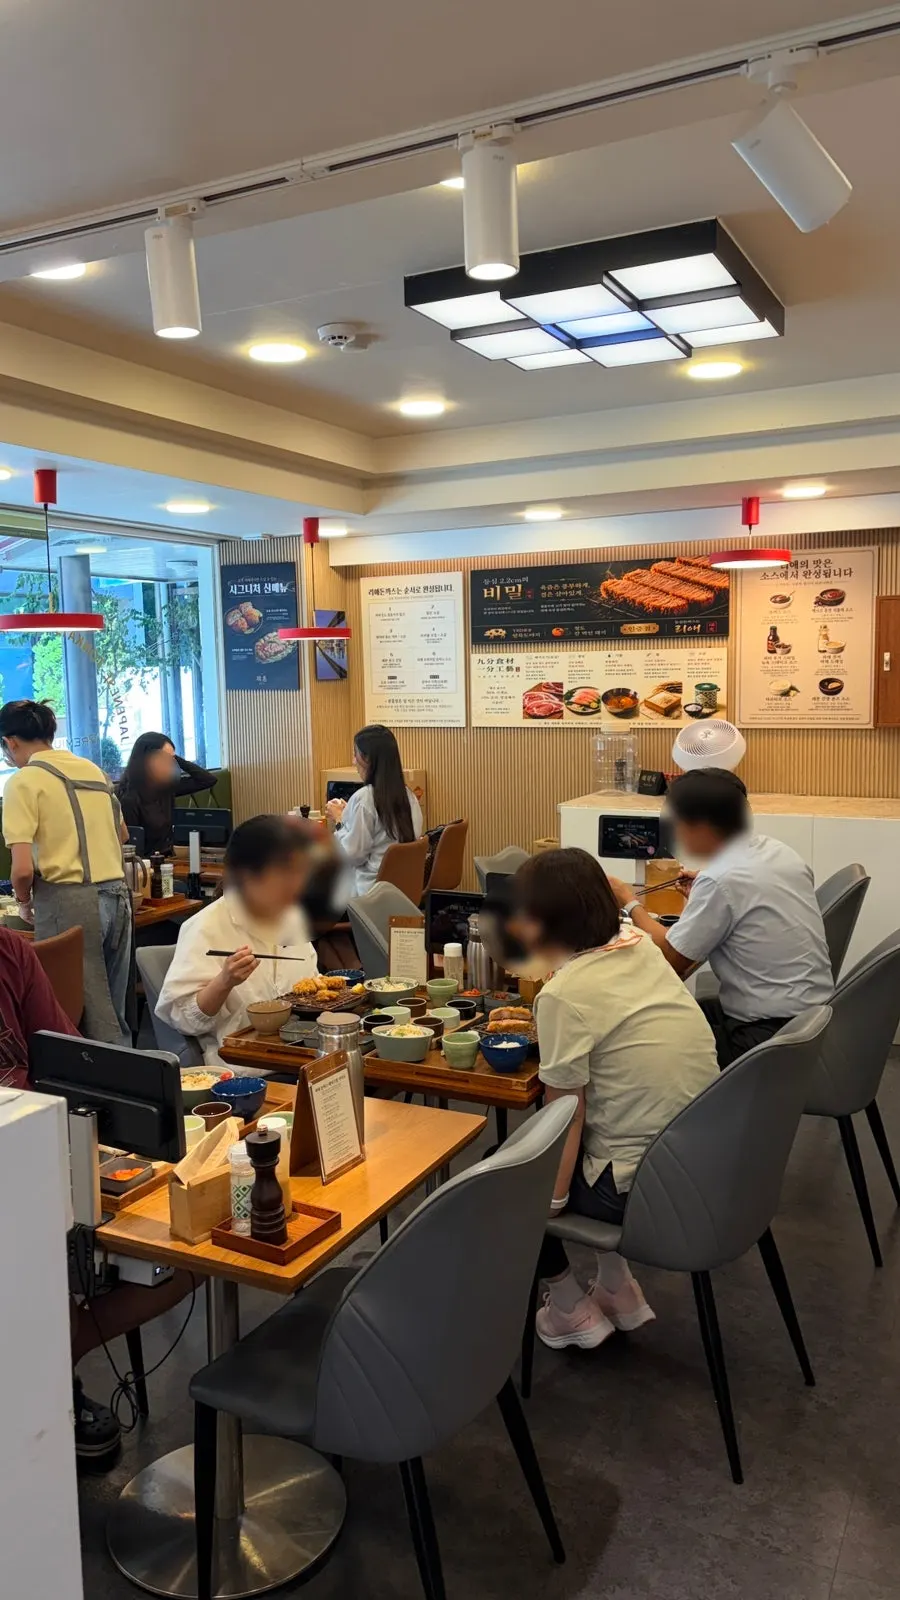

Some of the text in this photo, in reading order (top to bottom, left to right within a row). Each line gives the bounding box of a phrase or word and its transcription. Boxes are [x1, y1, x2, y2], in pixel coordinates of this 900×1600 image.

[812, 558, 832, 568] 맛은
[760, 568, 854, 580] 소스에서 완성됩니다
[229, 582, 287, 596] 시그니처 신메뉴
[404, 586, 421, 594] 순서로
[482, 584, 523, 600] 비밀
